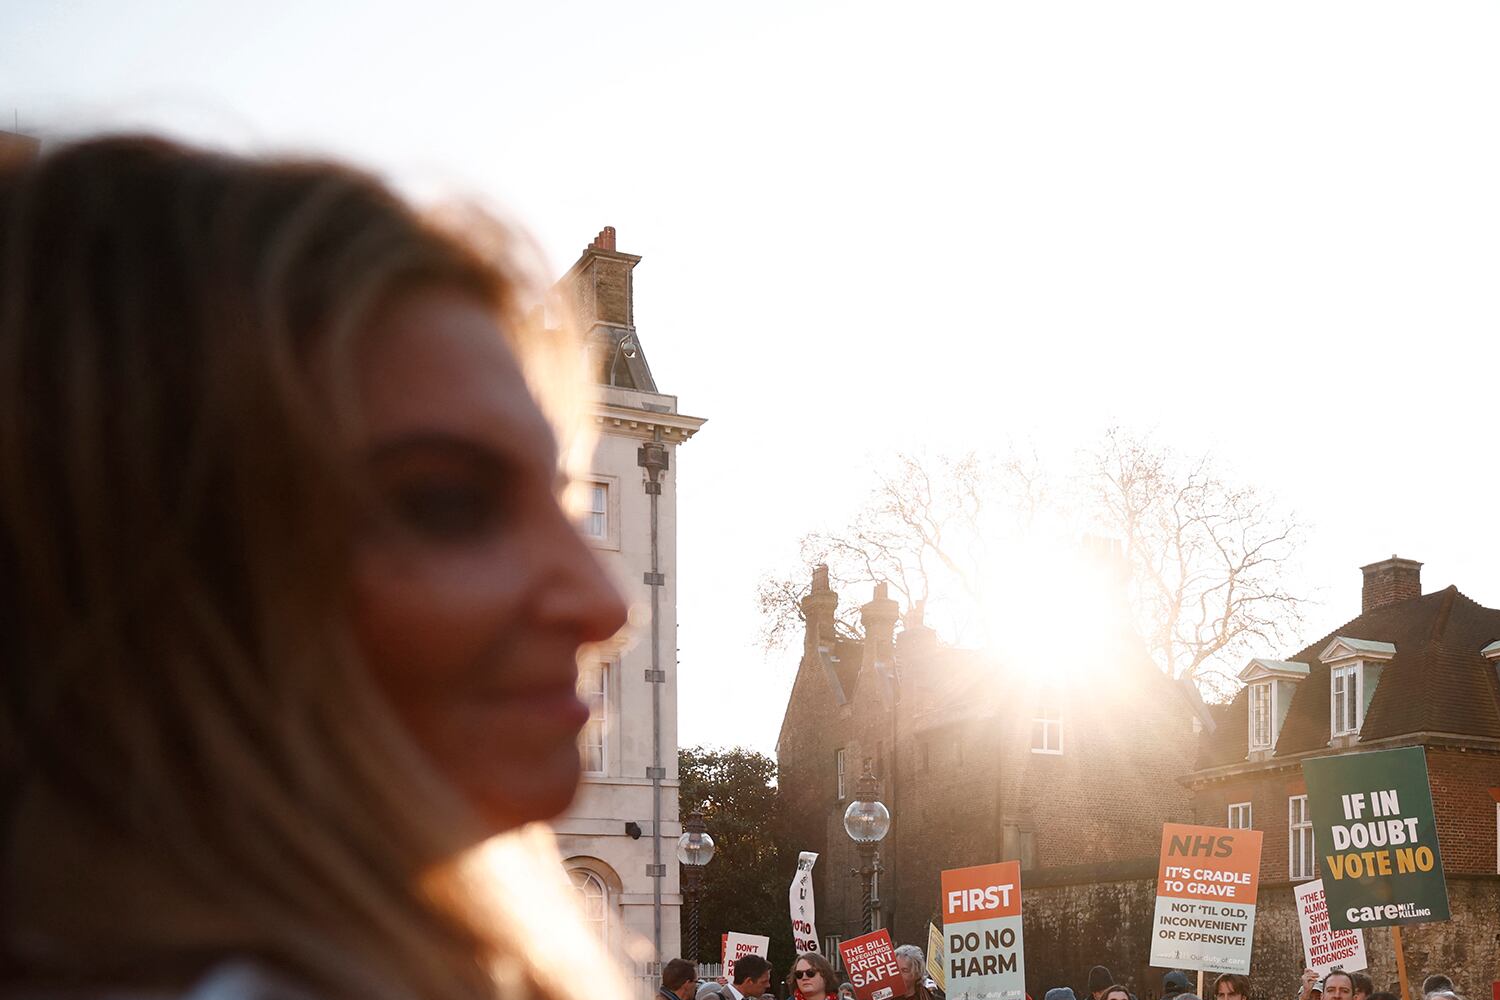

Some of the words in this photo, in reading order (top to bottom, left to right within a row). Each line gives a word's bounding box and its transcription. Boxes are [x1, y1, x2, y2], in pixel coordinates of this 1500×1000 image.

[1342, 793, 1366, 820] IF
[1370, 789, 1400, 817] IN
[1331, 818, 1419, 850] DOUBT
[1168, 835, 1234, 857] NHS
[1326, 852, 1393, 880] VOTE
[1396, 846, 1434, 874] NO
[1166, 866, 1191, 879] IT'S
[1194, 869, 1251, 884] CRADLE
[948, 884, 1013, 914] FIRST
[1164, 880, 1183, 892] TO
[1187, 882, 1236, 897] GRAVE
[1171, 903, 1196, 914] NOT
[1221, 908, 1248, 920] OLD,
[1346, 903, 1399, 923] care
[1160, 916, 1247, 932] INCONVENIENT
[844, 945, 864, 957] THE
[866, 938, 888, 950] BILL
[950, 932, 980, 953] DO
[985, 928, 1016, 950] NO
[1159, 930, 1175, 940] OR
[1179, 932, 1245, 946] EXPENSIVE!
[1309, 945, 1328, 956] WITH
[1330, 935, 1358, 951] WRONG
[1311, 936, 1321, 945] BY
[1323, 934, 1328, 942] 3
[850, 951, 893, 974] ARENT
[951, 952, 1017, 979] HARM
[852, 962, 900, 988] SAFE
